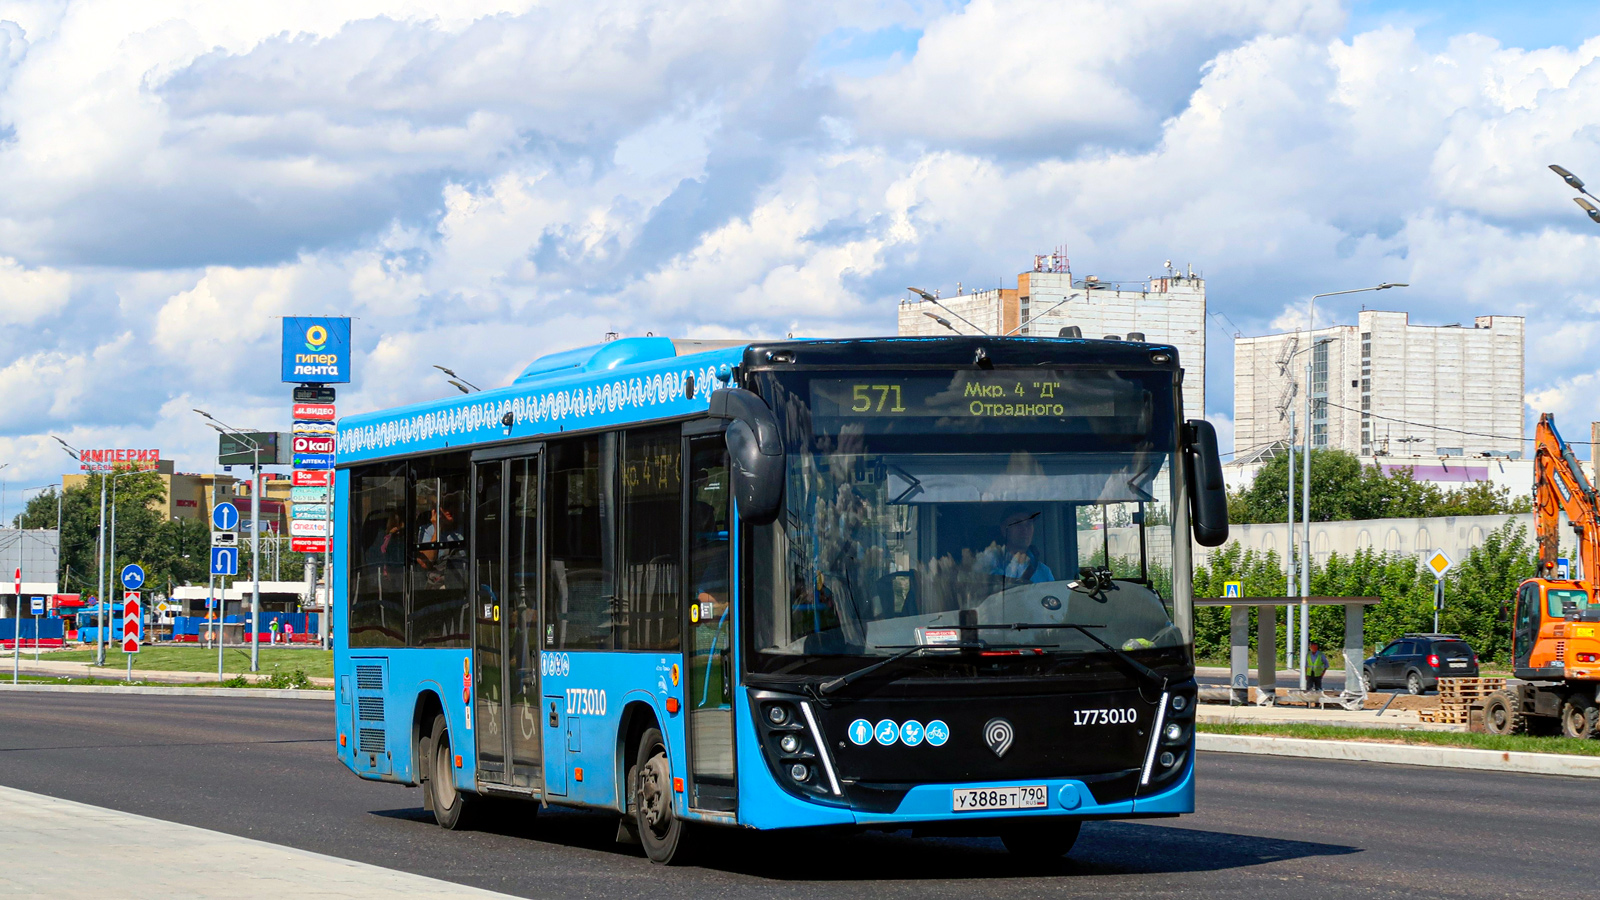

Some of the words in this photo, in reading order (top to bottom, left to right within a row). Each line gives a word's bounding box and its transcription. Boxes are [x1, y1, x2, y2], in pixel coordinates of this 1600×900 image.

[295, 353, 337, 365] гипер
[294, 365, 338, 375] лента
[964, 382, 1006, 398] Мкр.
[1014, 382, 1025, 397] 4
[852, 385, 906, 412] 571
[969, 400, 1064, 416] Отрадного
[308, 440, 333, 451] kari
[80, 449, 160, 462] ИМПЕРИЯ
[643, 456, 652, 485] 4
[565, 688, 607, 715] 1773010
[1073, 708, 1137, 726] 1773010
[959, 791, 1017, 808] У388ВТ
[1021, 788, 1043, 801] 790
